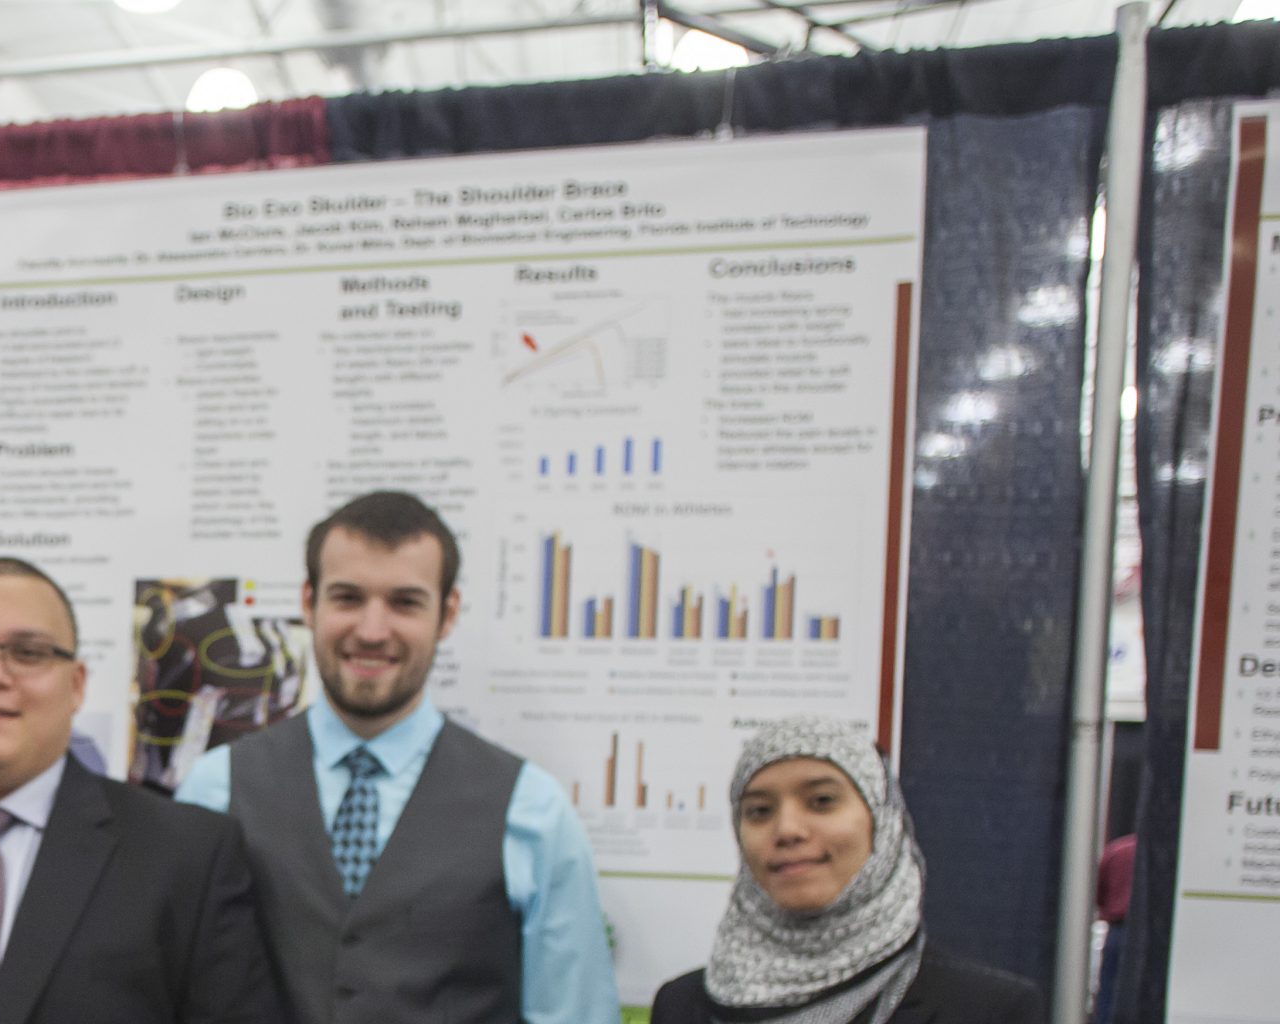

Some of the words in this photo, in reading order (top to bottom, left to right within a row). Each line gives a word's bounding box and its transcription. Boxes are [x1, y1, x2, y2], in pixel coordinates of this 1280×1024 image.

[223, 202, 255, 219] Bio
[263, 199, 299, 216] Exo
[414, 188, 450, 205] The
[458, 184, 555, 203] Shoulder
[563, 180, 628, 198] Brace
[782, 211, 870, 230] Technology
[516, 265, 598, 283] Results
[709, 258, 855, 277] Conclusions
[341, 274, 429, 293] Methods
[0, 291, 117, 309] Introduction
[175, 284, 245, 304] Design
[340, 302, 378, 319] and
[385, 300, 462, 320] Testing
